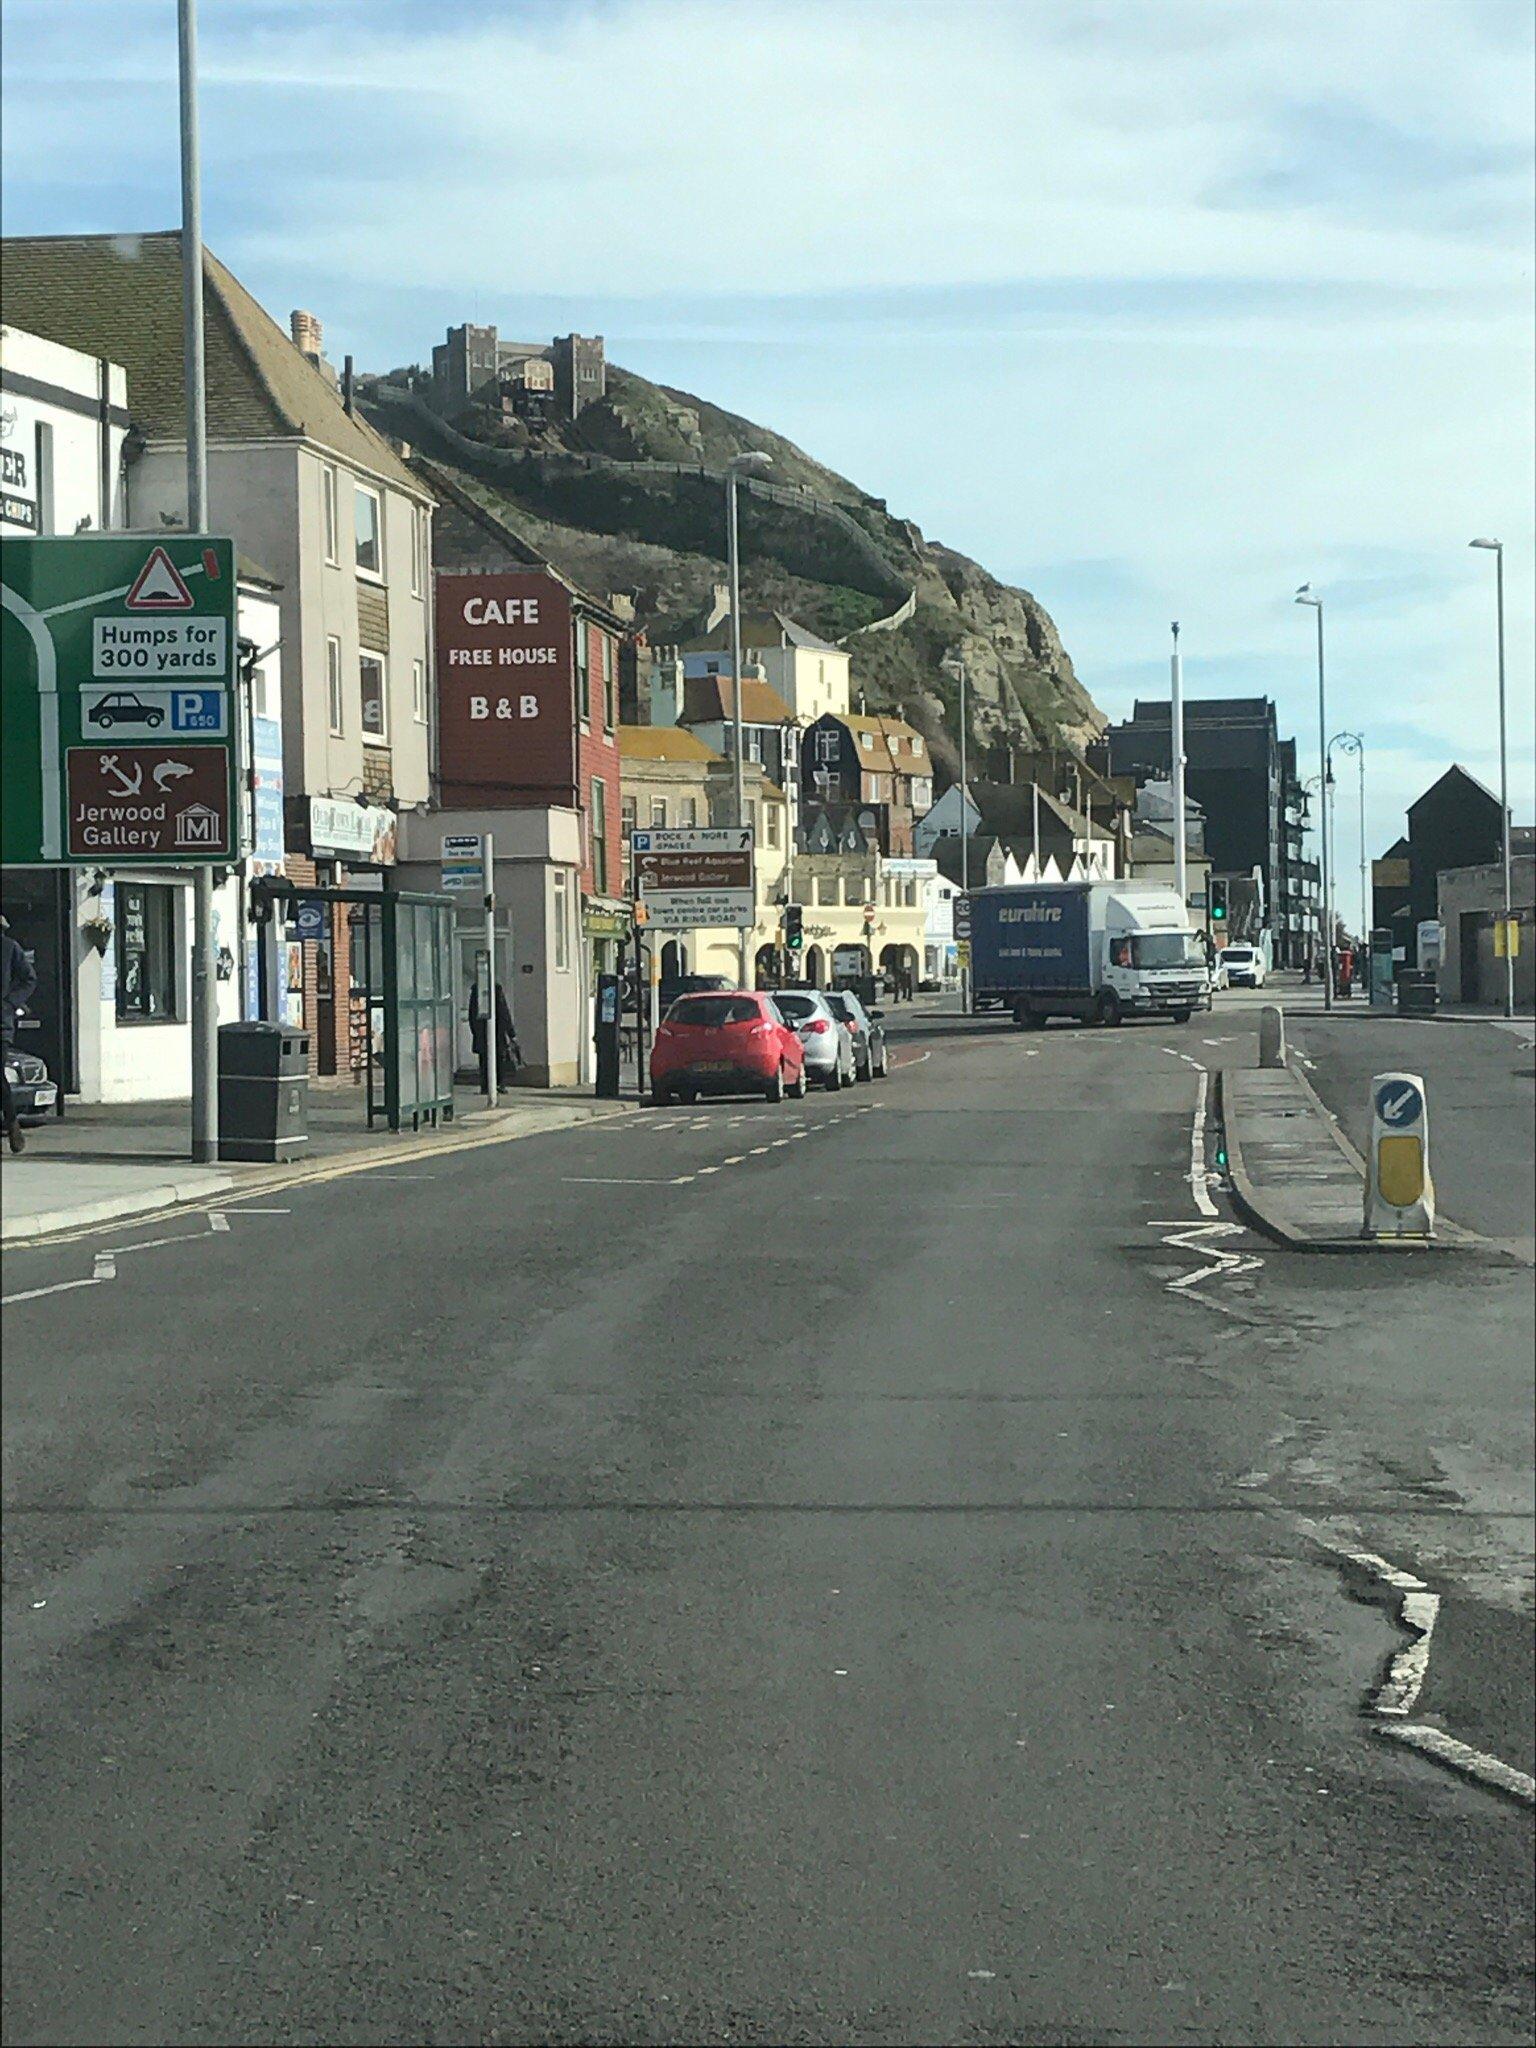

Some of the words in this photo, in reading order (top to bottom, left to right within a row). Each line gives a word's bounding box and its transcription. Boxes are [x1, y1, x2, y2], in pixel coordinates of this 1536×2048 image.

[463, 597, 539, 626] CAFE
[102, 626, 178, 646] Humps
[185, 625, 217, 643] for
[101, 649, 149, 667] 300
[157, 649, 217, 670] yards
[449, 649, 493, 666] FREE
[498, 648, 557, 665] HOUSE
[470, 696, 490, 719] B
[495, 698, 512, 719] &
[519, 695, 539, 718] B
[76, 803, 166, 822] Jerwood
[83, 826, 161, 848] Gallery
[663, 915, 679, 923] VIA
[709, 914, 737, 923] ROAD
